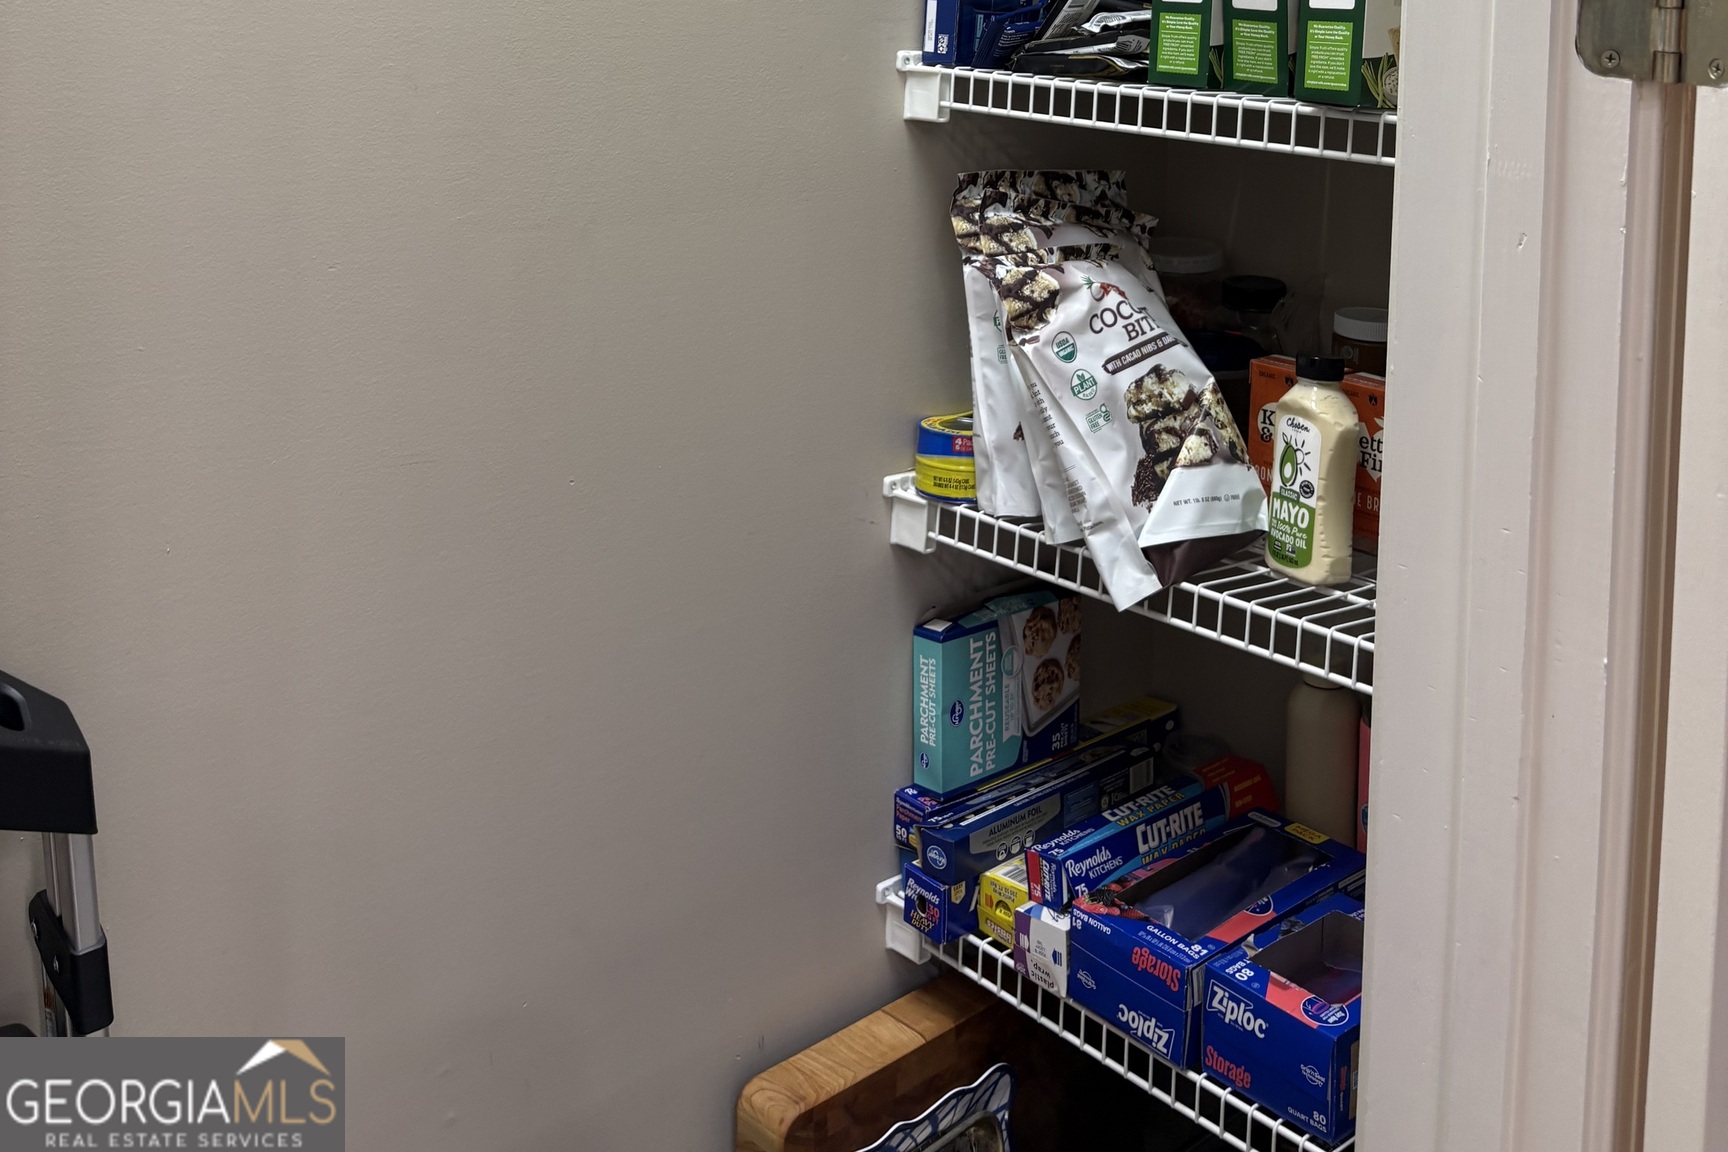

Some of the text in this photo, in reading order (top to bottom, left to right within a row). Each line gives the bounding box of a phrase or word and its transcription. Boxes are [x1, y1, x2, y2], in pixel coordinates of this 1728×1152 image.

[1056, 337, 1070, 349] USDA
[1121, 349, 1141, 365] CACAO
[1140, 342, 1158, 355] NIBS
[1073, 378, 1095, 394] PLANT
[1272, 497, 1309, 528] MAYO
[1270, 527, 1307, 549] AVOCADO OIL
[1291, 526, 1308, 539] Pure
[920, 654, 929, 744] PARCHMENT
[969, 638, 983, 777] PARCHMENT
[986, 631, 996, 771] PRE-CUT SHEETS
[1101, 785, 1177, 822] CUT-RITE
[1117, 793, 1185, 826] WAX PAPER
[988, 813, 1027, 837] ALUMINUM
[1027, 805, 1042, 817] FOIL
[1136, 801, 1204, 855] CUT-RITE
[1031, 829, 1080, 852] Reynolds
[1065, 846, 1112, 878] Reynolds
[1088, 856, 1123, 879] KITCHENS
[907, 877, 940, 904] Reynolds
[1075, 883, 1089, 898] 75
[1072, 916, 1082, 930] 81
[1073, 908, 1111, 935] GALLON BAGS
[1146, 925, 1179, 945] GALLON
[1177, 942, 1200, 960] BAGS
[1190, 944, 1209, 957] 81
[1131, 946, 1181, 992] Storage
[1212, 985, 1266, 1039] Ziploc
[1117, 1003, 1170, 1054] Ziploc
[1204, 1045, 1251, 1089] Storage
[1287, 1106, 1327, 1133] QUART BAGS
[1313, 1110, 1327, 1125] 80
